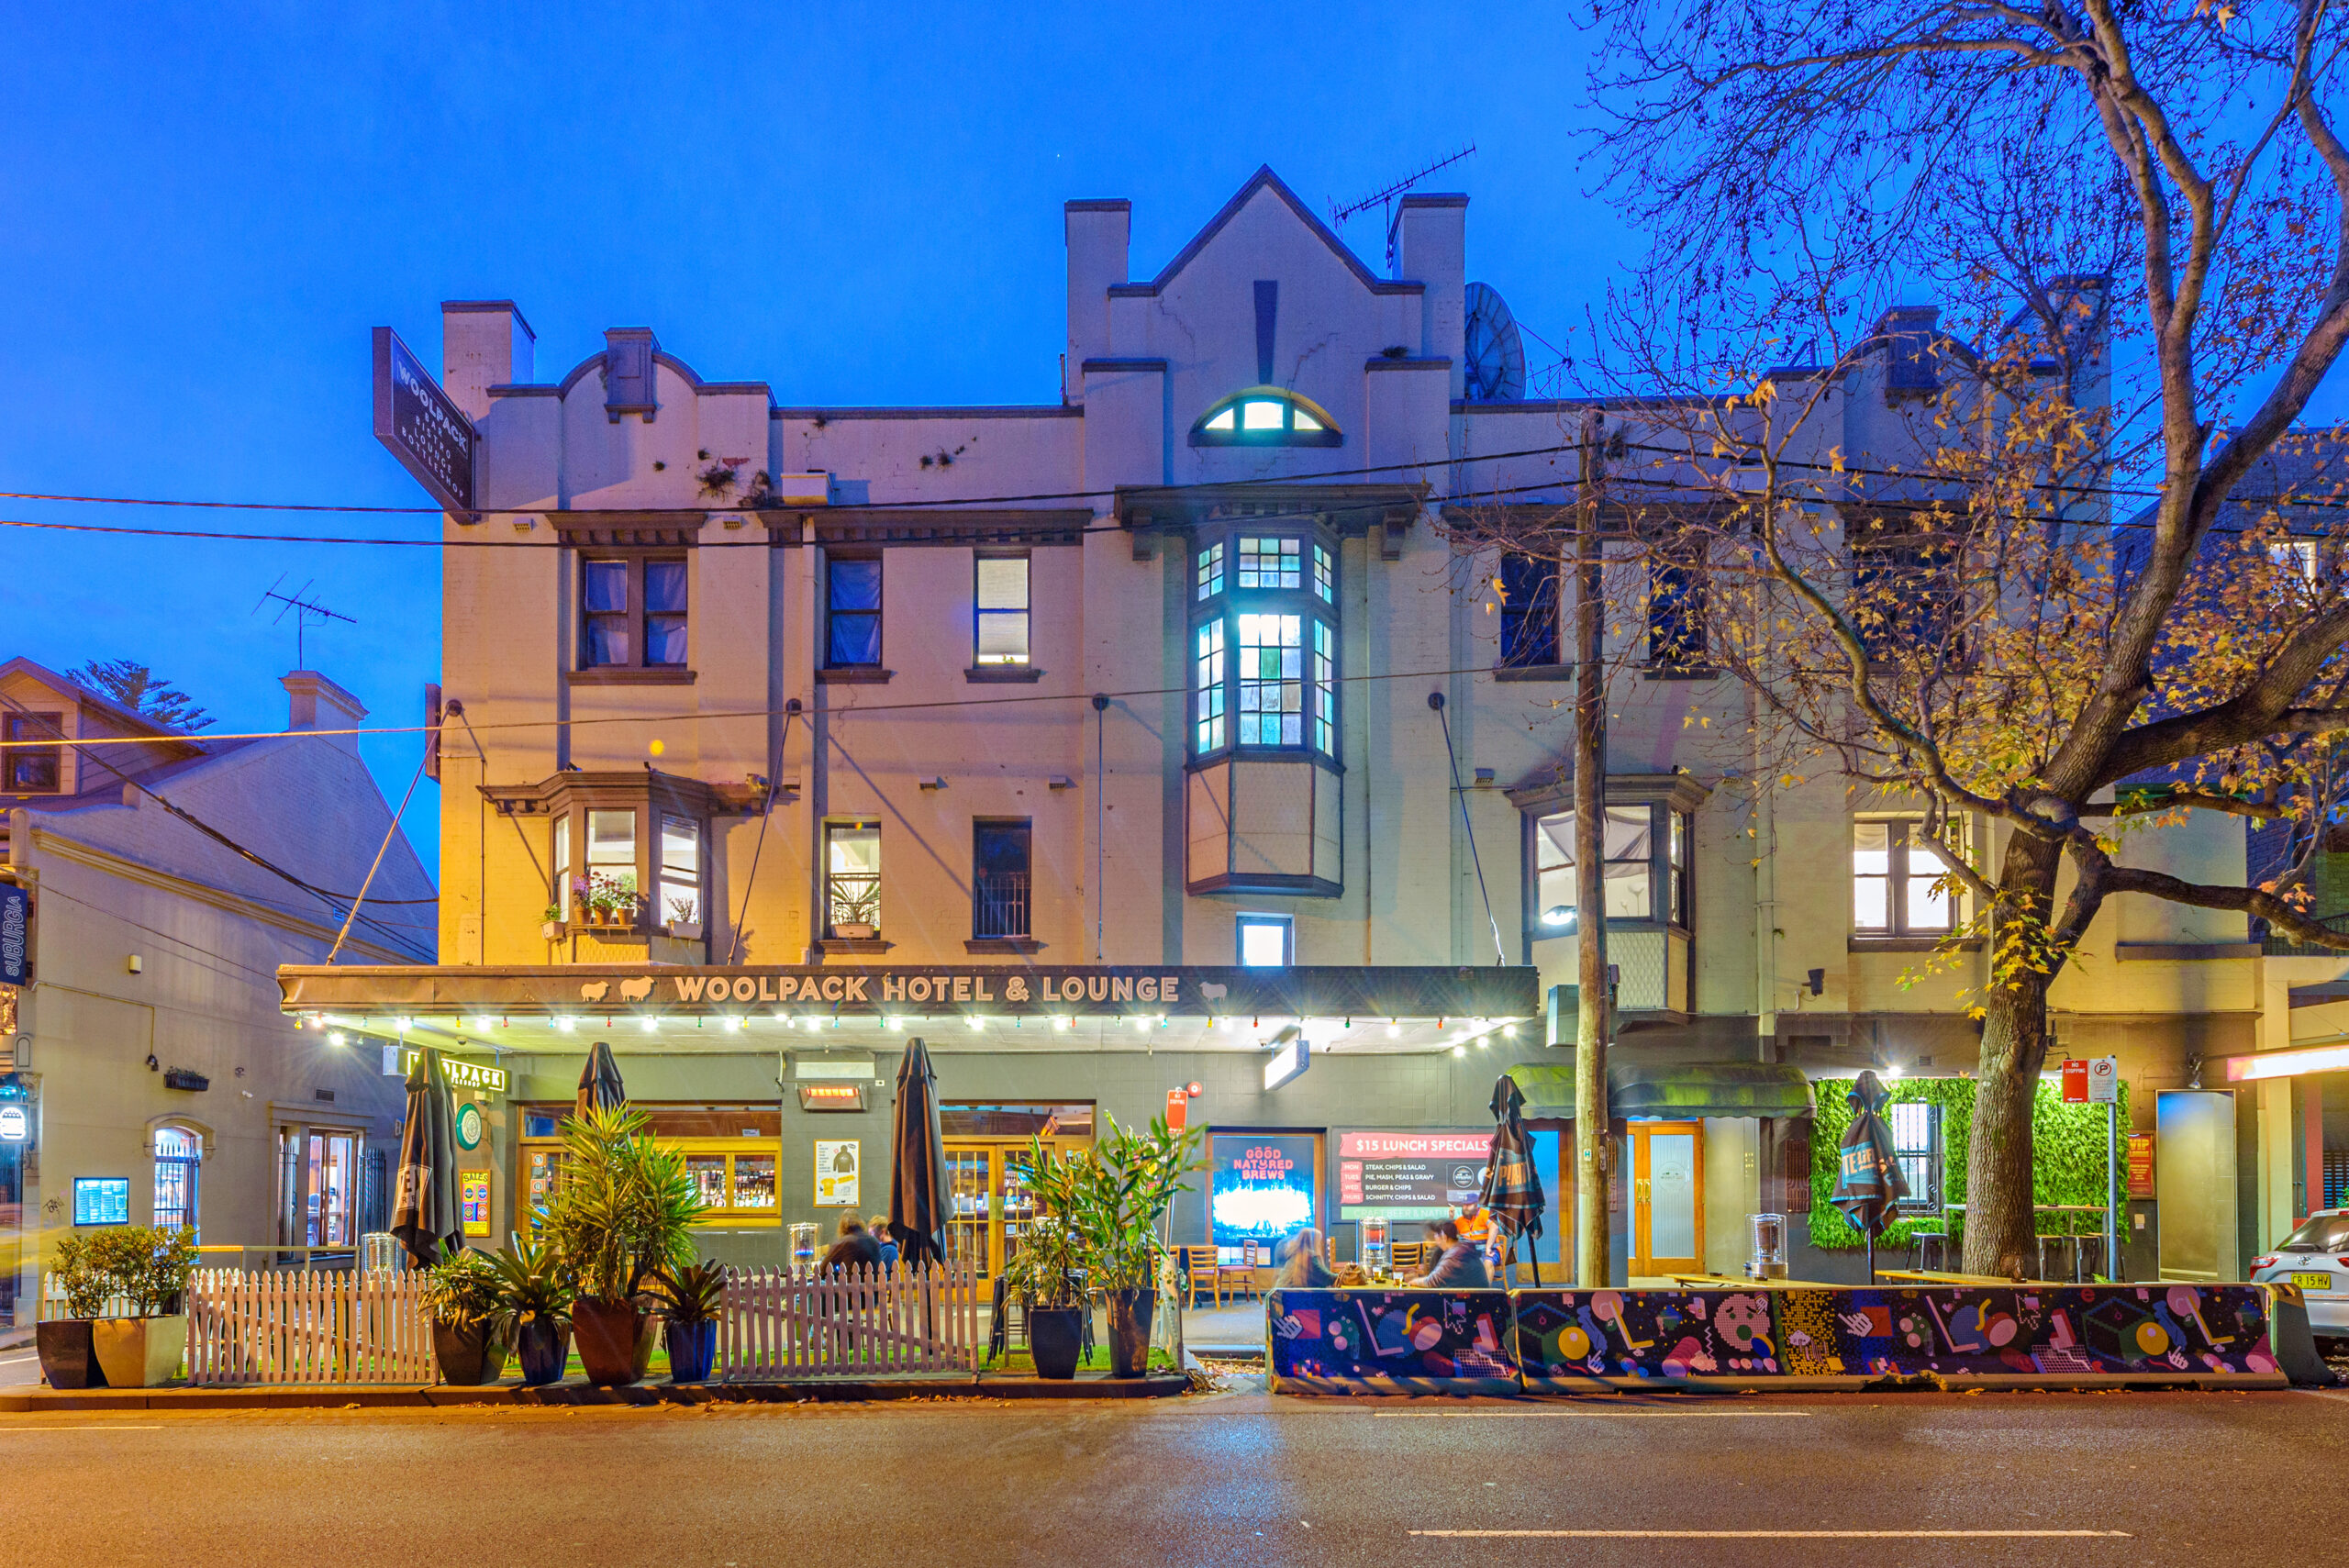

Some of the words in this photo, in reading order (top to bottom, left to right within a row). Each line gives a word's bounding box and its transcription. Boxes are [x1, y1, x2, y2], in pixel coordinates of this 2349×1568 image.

[398, 361, 467, 452] WOOLPACK
[416, 415, 451, 460] BISTRO
[425, 413, 443, 438] BAR
[402, 426, 463, 498] BOTTLESHOP
[415, 427, 451, 475] LOUNGE
[3, 895, 25, 977] SUBURGIA
[674, 976, 868, 1002] WOOLPACK
[883, 975, 993, 1002] HOTEL
[1006, 976, 1030, 1002] &
[1042, 976, 1179, 1002] LOUNGE
[1356, 1140, 1379, 1152] $15
[1383, 1140, 1427, 1151] LUNCH
[1431, 1140, 1488, 1152] SPECIALS
[1233, 1159, 1294, 1170] NATURED
[1241, 1170, 1286, 1180] BREWS
[463, 1173, 488, 1183] SALES
[1387, 1210, 1411, 1218] BEER
[1413, 1210, 1419, 1218] &
